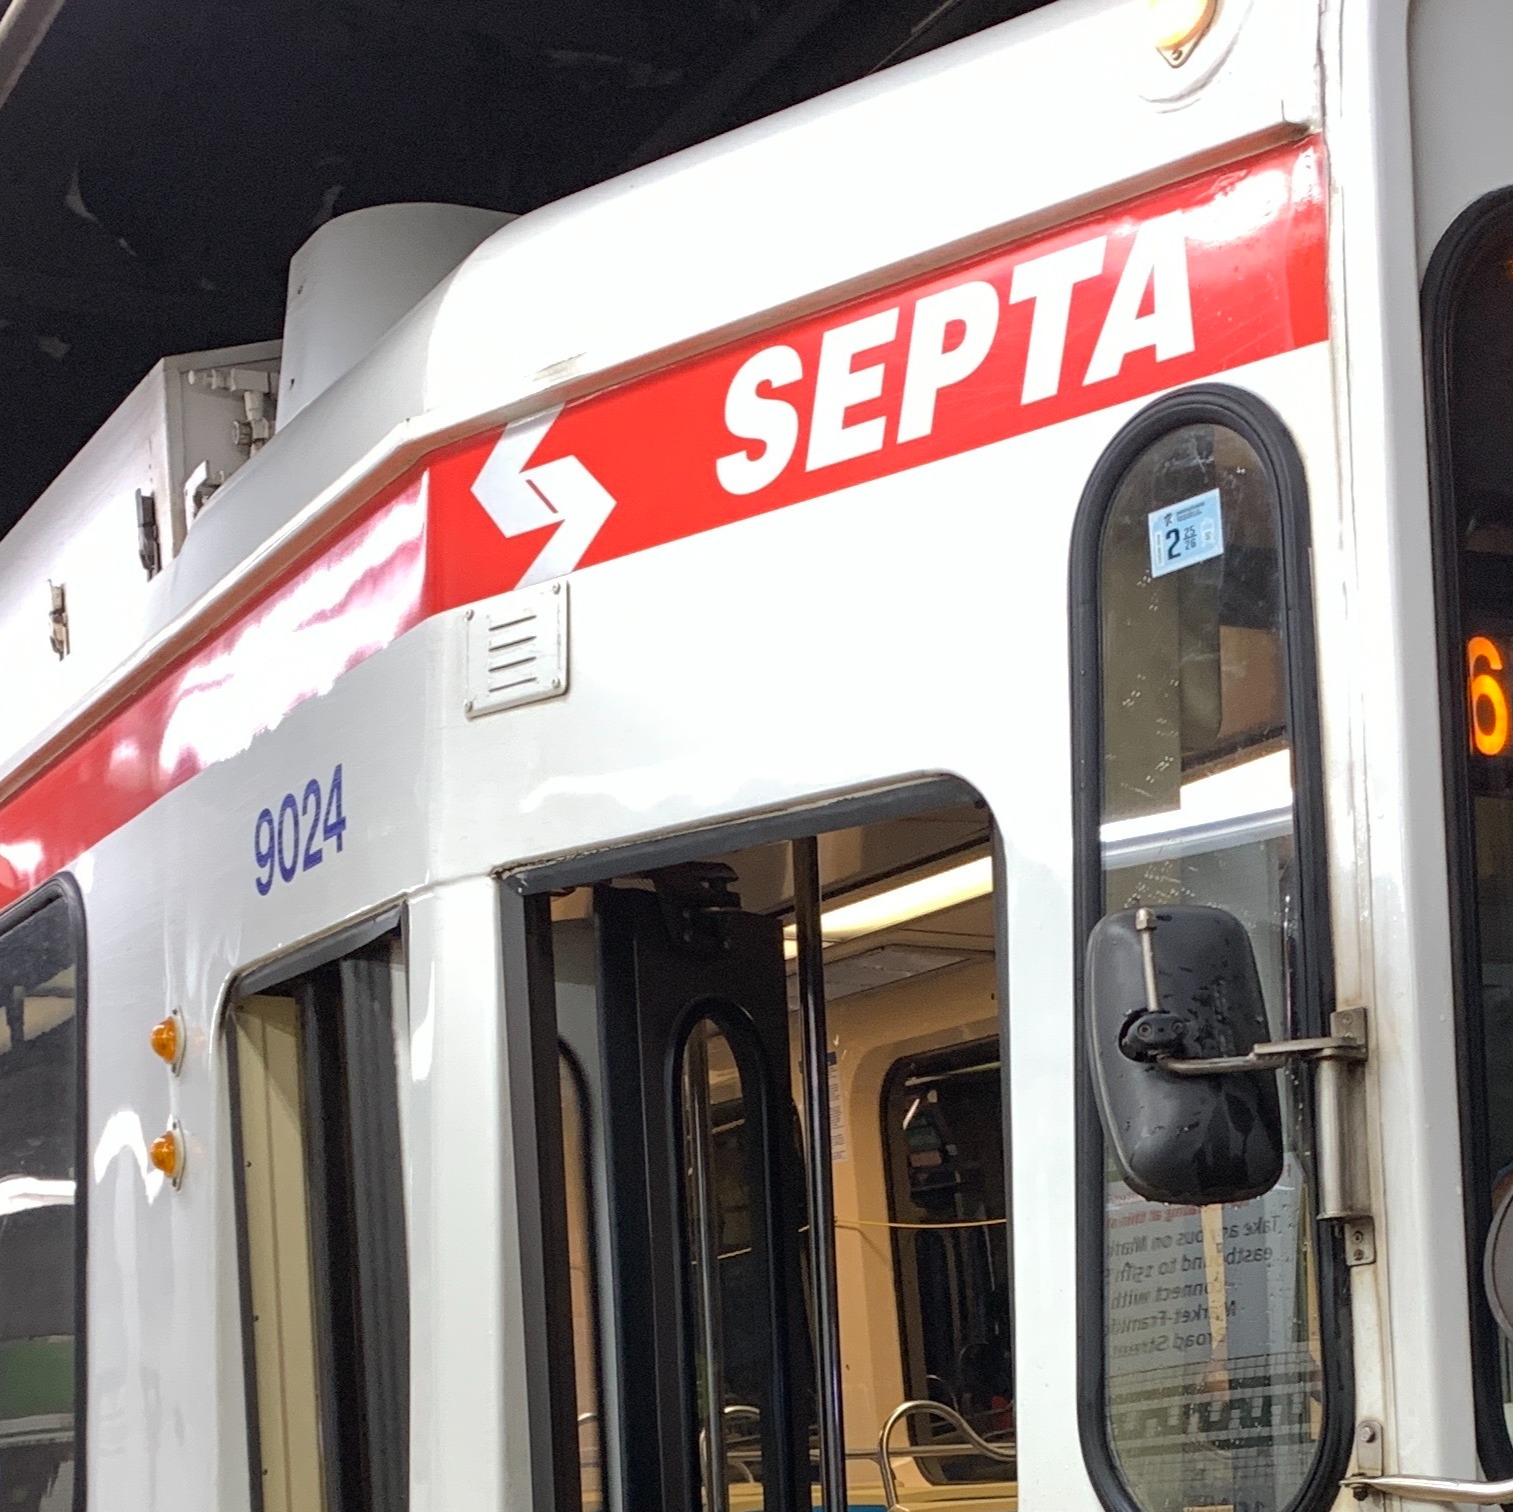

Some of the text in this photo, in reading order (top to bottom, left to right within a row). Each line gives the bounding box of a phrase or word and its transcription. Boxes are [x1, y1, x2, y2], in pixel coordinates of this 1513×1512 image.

[716, 211, 1196, 496] SEPTA
[1165, 528, 1181, 560] 2
[254, 764, 346, 896] 9024
